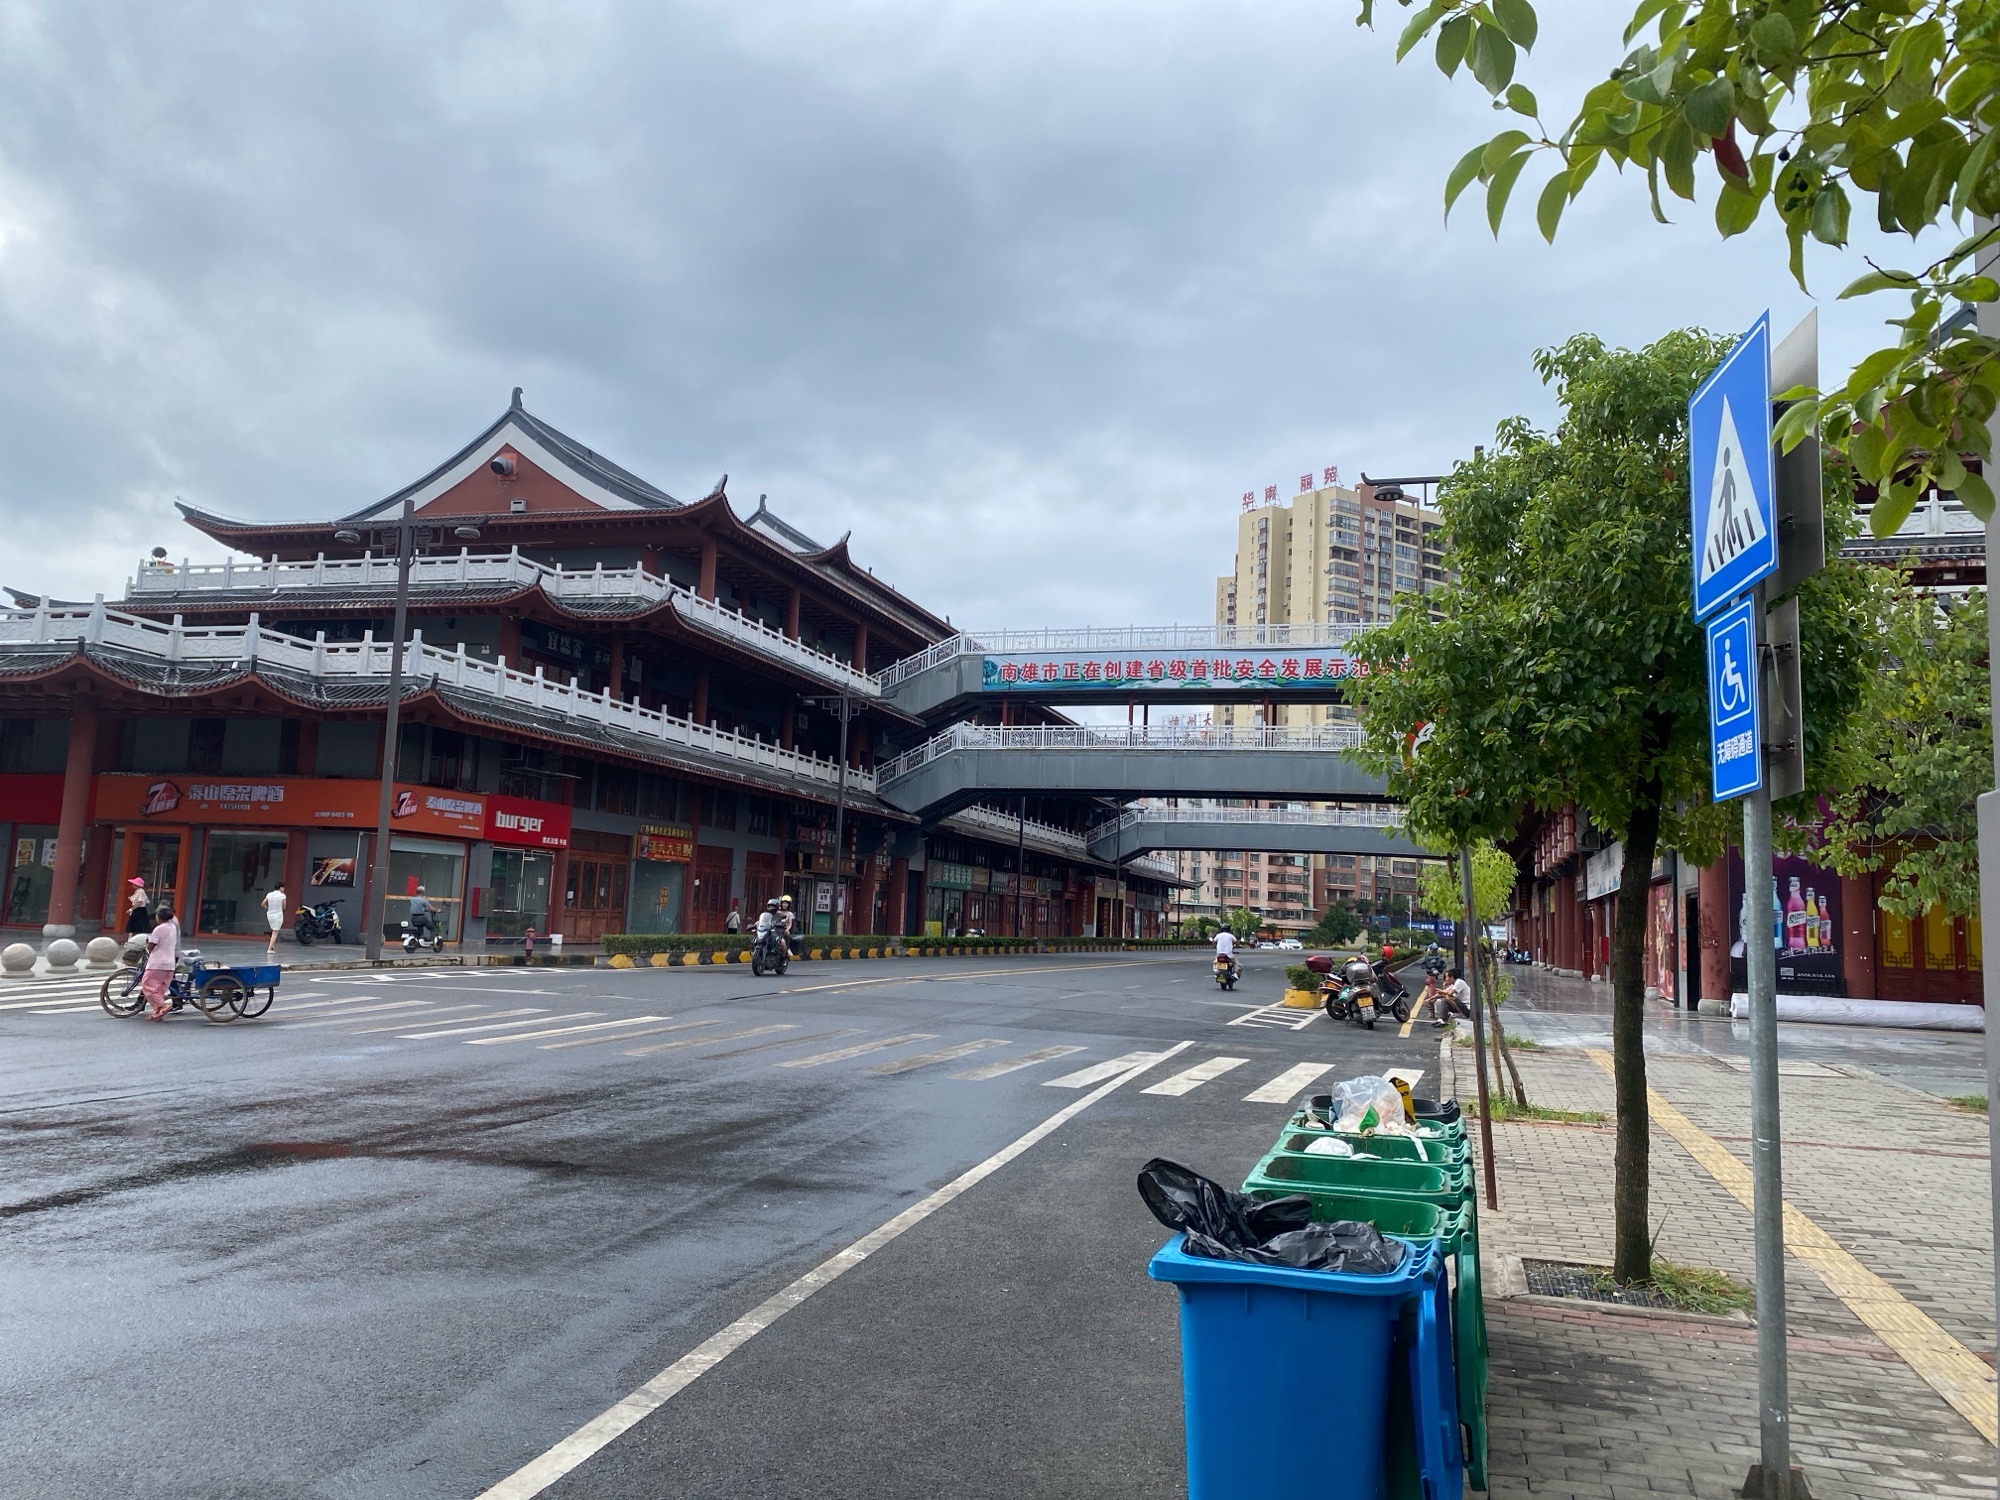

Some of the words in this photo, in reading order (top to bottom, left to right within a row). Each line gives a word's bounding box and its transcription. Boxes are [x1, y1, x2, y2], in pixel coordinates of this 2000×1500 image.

[1242, 466, 1338, 504] 华南丽苑
[1001, 657, 1414, 680] 南雄市正在创建省级首批安全发展示范
[1717, 729, 1754, 765] 无障碍通道
[188, 784, 284, 803] 泰山原浆啤酒
[426, 796, 483, 815] 泰山原浆啤酒
[495, 811, 544, 833] burger
